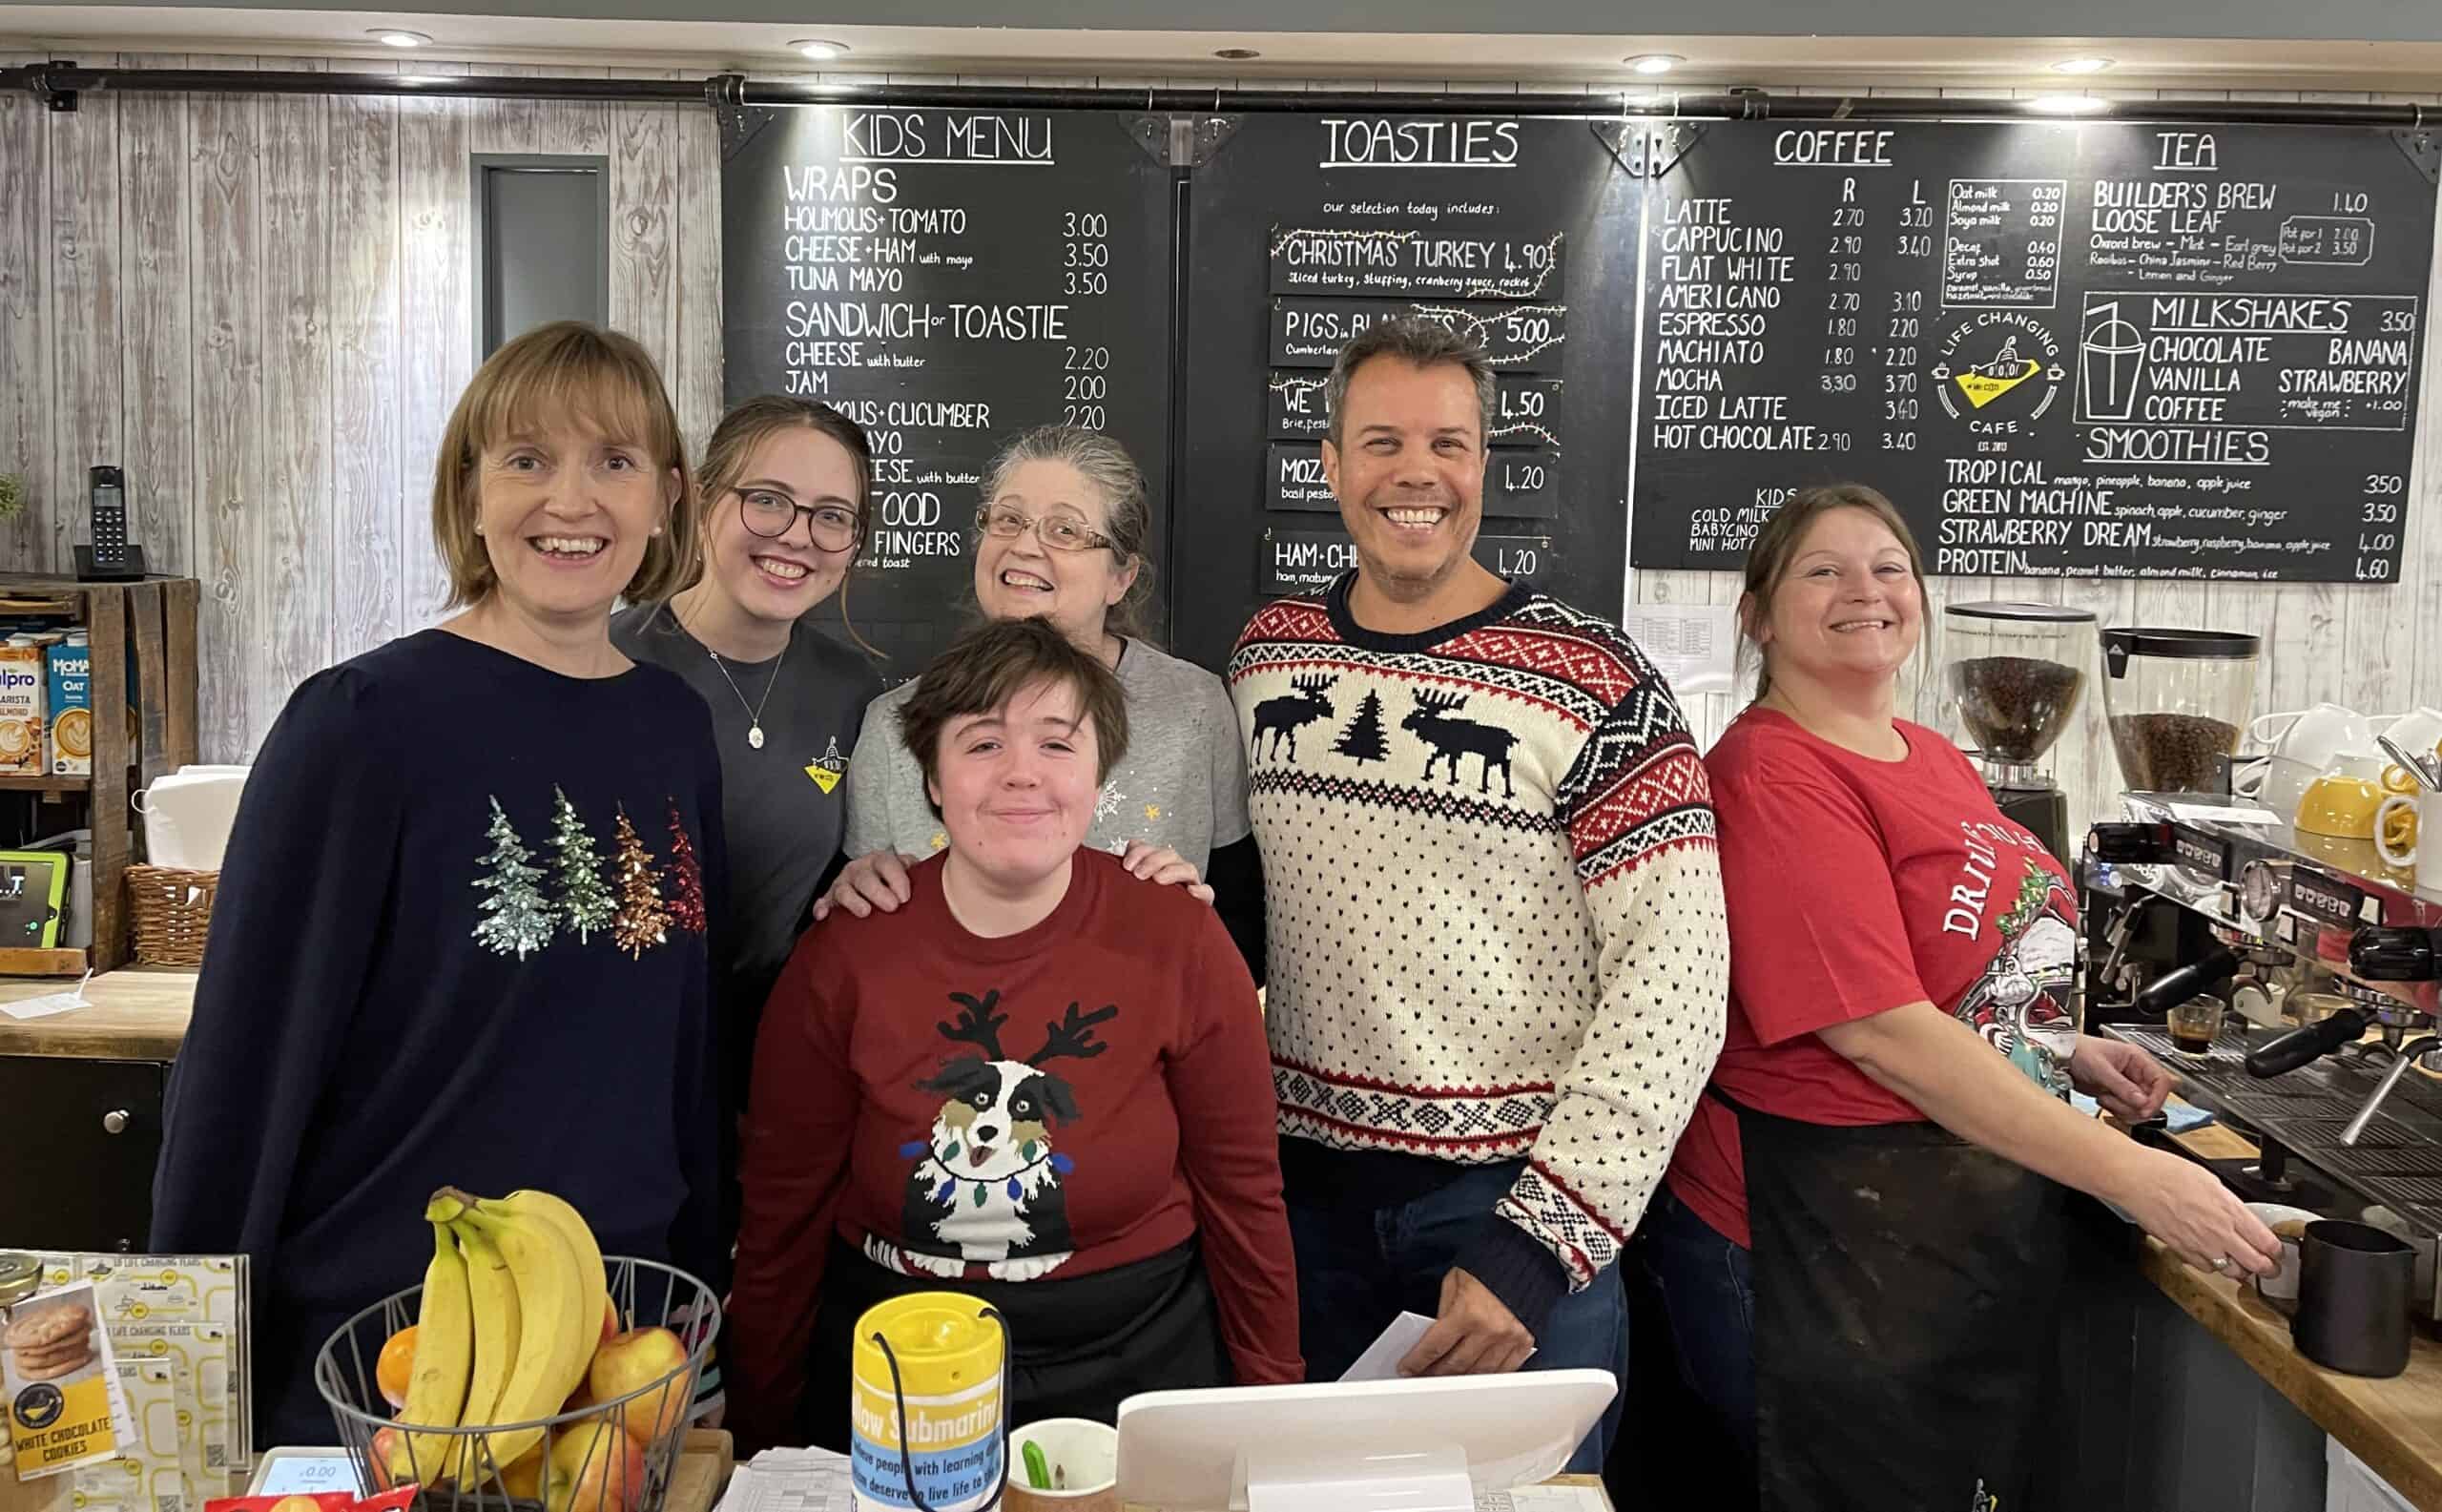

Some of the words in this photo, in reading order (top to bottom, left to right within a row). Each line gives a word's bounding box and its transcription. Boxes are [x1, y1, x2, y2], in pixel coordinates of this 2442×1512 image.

[843, 114, 925, 157] KIDS
[946, 116, 1052, 159] MENU
[1321, 119, 1520, 163] TOASTIES
[1774, 130, 1894, 163] COFFEE
[2156, 133, 2217, 167] TEA
[784, 166, 898, 203] WRAPS
[1843, 176, 1855, 202] R
[1913, 179, 1927, 204] L
[1975, 185, 1997, 198] milk
[2032, 187, 2060, 200] 0.20
[2093, 180, 2208, 210] BUILDER'S
[2217, 183, 2277, 211] BREW
[2334, 192, 2369, 213] 1.40
[1350, 200, 1399, 215] selection
[1407, 200, 1438, 220] today
[1664, 198, 1733, 225] LATTE
[1899, 206, 1933, 228] 3.20
[1952, 198, 1989, 213] Almond
[2031, 201, 2059, 214] 0.20
[888, 208, 966, 237] TOMATO
[1062, 212, 1108, 238] 3.00
[1950, 212, 1977, 230] Soya
[2030, 215, 2055, 227] 0.20
[2092, 208, 2163, 234] LOOSE
[2170, 210, 2226, 235] LEAF
[784, 237, 862, 263] CHEESE
[875, 238, 916, 264] HAM
[919, 253, 941, 265] with
[946, 254, 974, 271] mayo
[1063, 243, 1109, 268] 3.50
[1288, 238, 1399, 267] CHRISTMAS
[1411, 240, 1497, 269] TURKEY
[1504, 242, 1547, 273] 4.90
[1662, 226, 1784, 253] CAPPUCINO
[1897, 235, 1932, 259] 3.40
[2132, 236, 2162, 250] brew
[2225, 235, 2249, 253] Earl
[1661, 256, 1715, 281] FLAT
[1727, 257, 1794, 282] WHITE
[2139, 253, 2167, 266] China
[2169, 250, 2212, 267] Jasmine
[2223, 253, 2245, 269] Red
[2246, 256, 2277, 273] Berry
[785, 266, 839, 293] TUNA
[849, 268, 903, 293] MAYO
[1064, 271, 1108, 297] 3.50
[1416, 276, 1463, 292] cranberry
[2139, 268, 2172, 280] Lemon
[2176, 270, 2196, 281] and
[2200, 270, 2235, 285] Ginger
[1659, 284, 1781, 309] AMERICANO
[1893, 290, 1921, 312] 3.10
[785, 301, 930, 340] SANDWICH
[930, 313, 947, 328] or
[948, 304, 1069, 342] TOASTIE
[1286, 311, 1340, 339] PIGS
[1659, 312, 1766, 337] ESPRESSO
[1828, 318, 1856, 337] 1.80
[2151, 298, 2352, 331] MILKSHAKES
[1940, 321, 1974, 356] LIFE
[1977, 311, 2059, 357] CHANGING
[785, 342, 863, 367] CHEESE
[866, 354, 891, 368] with
[892, 354, 928, 369] butter
[1064, 346, 1109, 371] 2.20
[1285, 343, 1338, 356] Cumberlan
[1657, 340, 1765, 364] MACHIATO
[1825, 346, 1853, 365] 1.80
[2149, 335, 2272, 362] CHOCOLATE
[2328, 338, 2408, 366] BANANA
[785, 370, 829, 395] JAM
[1064, 375, 1107, 402] 2.00
[1655, 368, 1724, 392] MOCHA
[1885, 372, 1917, 393] 3.70
[2149, 367, 2242, 391] VANILLA
[2279, 368, 2408, 395] STRAWBERRY
[888, 403, 990, 428] CUCUMBER
[1283, 387, 1313, 413] WE
[1501, 390, 1544, 419] 4.50
[1655, 394, 1707, 421] ICED
[1719, 396, 1788, 421] LATTE
[2145, 396, 2227, 422] COFFEE
[2305, 408, 2341, 422] vegan
[1653, 425, 1696, 449] HOT
[1700, 425, 1816, 451] CHOCOLATE
[1817, 432, 1852, 451] 2.90
[1881, 431, 1916, 451] 3.40
[1970, 420, 2018, 434] CAFE
[2085, 426, 2270, 463] SMOOTHIES
[917, 472, 942, 485] with
[945, 472, 981, 485] butter
[1504, 466, 1545, 489] 4.20
[1945, 458, 2048, 485] TROPICAL
[2224, 478, 2251, 493] juice
[1281, 487, 1305, 499] basil
[1690, 507, 1731, 523] COLD
[1736, 507, 1770, 523] MILK
[1942, 488, 2012, 513] GREEN
[2019, 489, 2115, 516] MACHINE
[2248, 509, 2288, 527] ginger
[1689, 537, 1715, 551] MINI
[1690, 523, 1760, 538] BABYCINO
[1938, 518, 2072, 546] STRAWBERRY
[2083, 521, 2152, 548] DREAM
[2358, 532, 2395, 553] 4.00
[882, 556, 911, 569] toast
[1275, 542, 1317, 567] HAM
[1498, 549, 1537, 575] 4.20
[1937, 548, 2026, 574] PROTEIN
[2263, 570, 2279, 580] ice
[0, 695, 31, 704] ARISTA
[50, 1417, 113, 1443] CHOCOLATE
[888, 1398, 998, 1443] Submarin
[43, 1440, 88, 1462] COOKIES
[876, 1458, 906, 1477] peopl
[915, 1460, 940, 1476] with
[942, 1450, 983, 1474] learning
[869, 1478, 909, 1502] deserve
[928, 1486, 949, 1502] live
[953, 1481, 970, 1498] life
[972, 1475, 983, 1487] to
